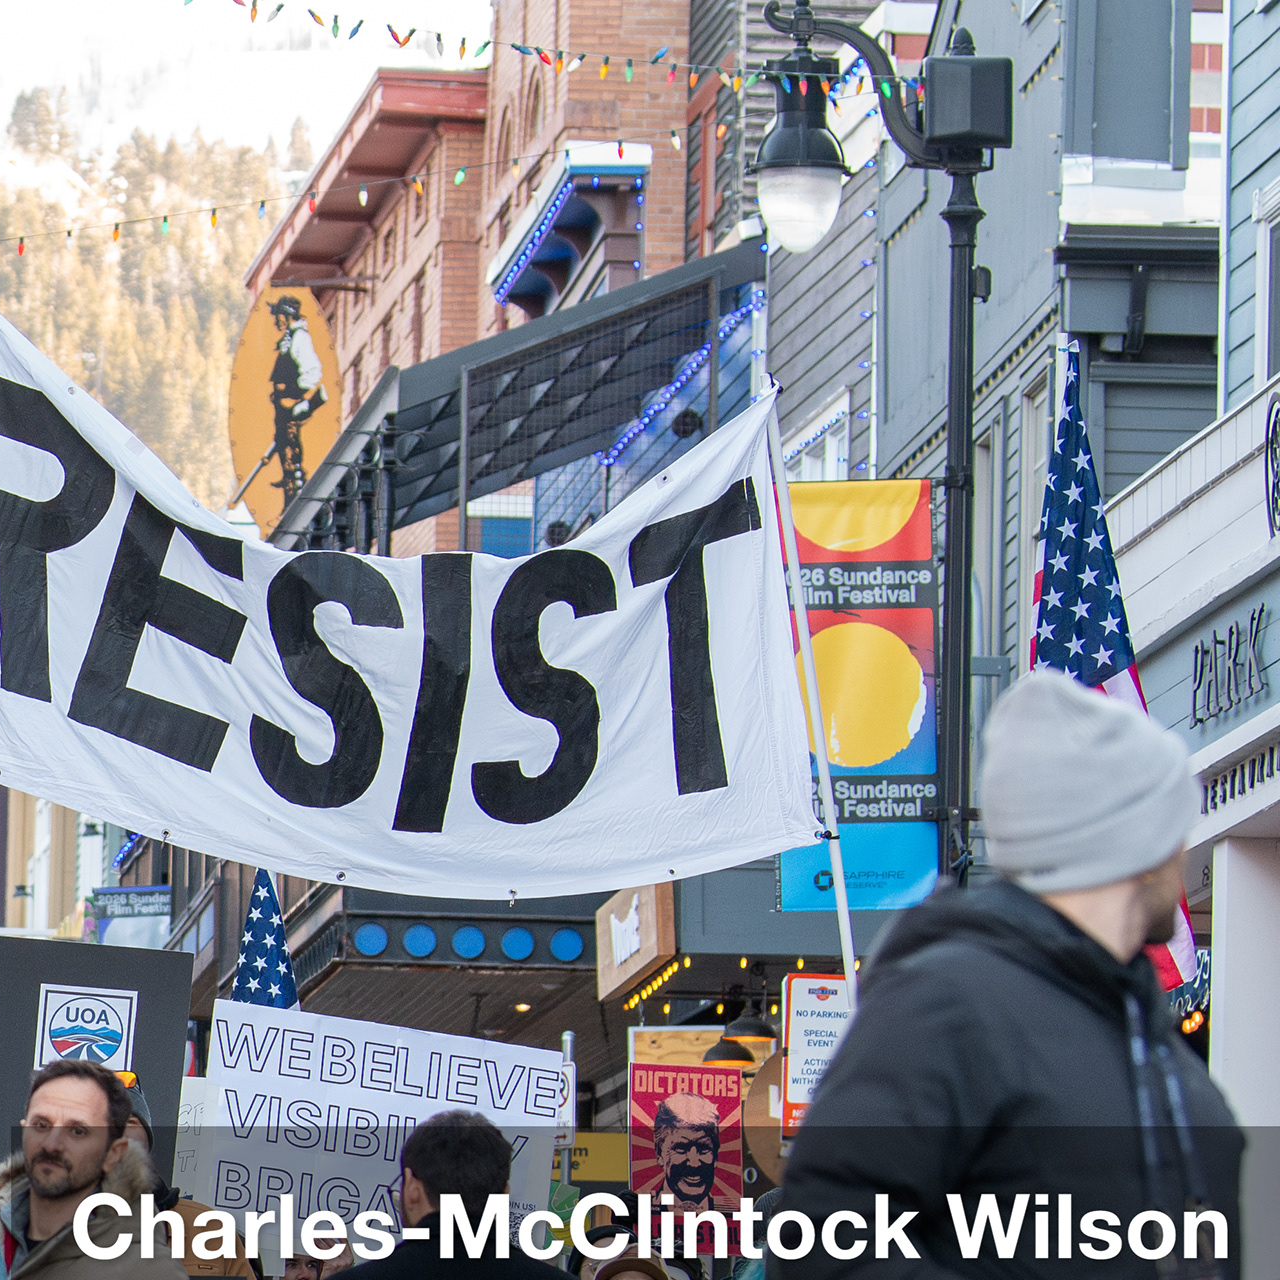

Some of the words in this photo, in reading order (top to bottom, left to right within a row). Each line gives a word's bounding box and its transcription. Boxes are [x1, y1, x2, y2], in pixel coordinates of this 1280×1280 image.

[829, 566, 932, 586] Sundance
[798, 586, 834, 605] ilm
[838, 585, 916, 604] Festival
[1190, 602, 1265, 730] PARK
[835, 780, 937, 799] Sundance
[844, 798, 922, 818] Festival
[843, 870, 905, 880] SAPPHIRE
[98, 894, 127, 905] 2026
[107, 904, 132, 915] Film
[65, 1006, 111, 1026] UOA
[796, 1009, 809, 1018] NO
[810, 1010, 849, 1019] PARKING
[803, 1029, 840, 1039] SPECIAL
[807, 1039, 835, 1048] EVENT
[803, 1058, 831, 1067] ACTIV
[634, 1069, 739, 1098] DICTATORS
[792, 1077, 814, 1085] WITH
[522, 1203, 537, 1212] US!
